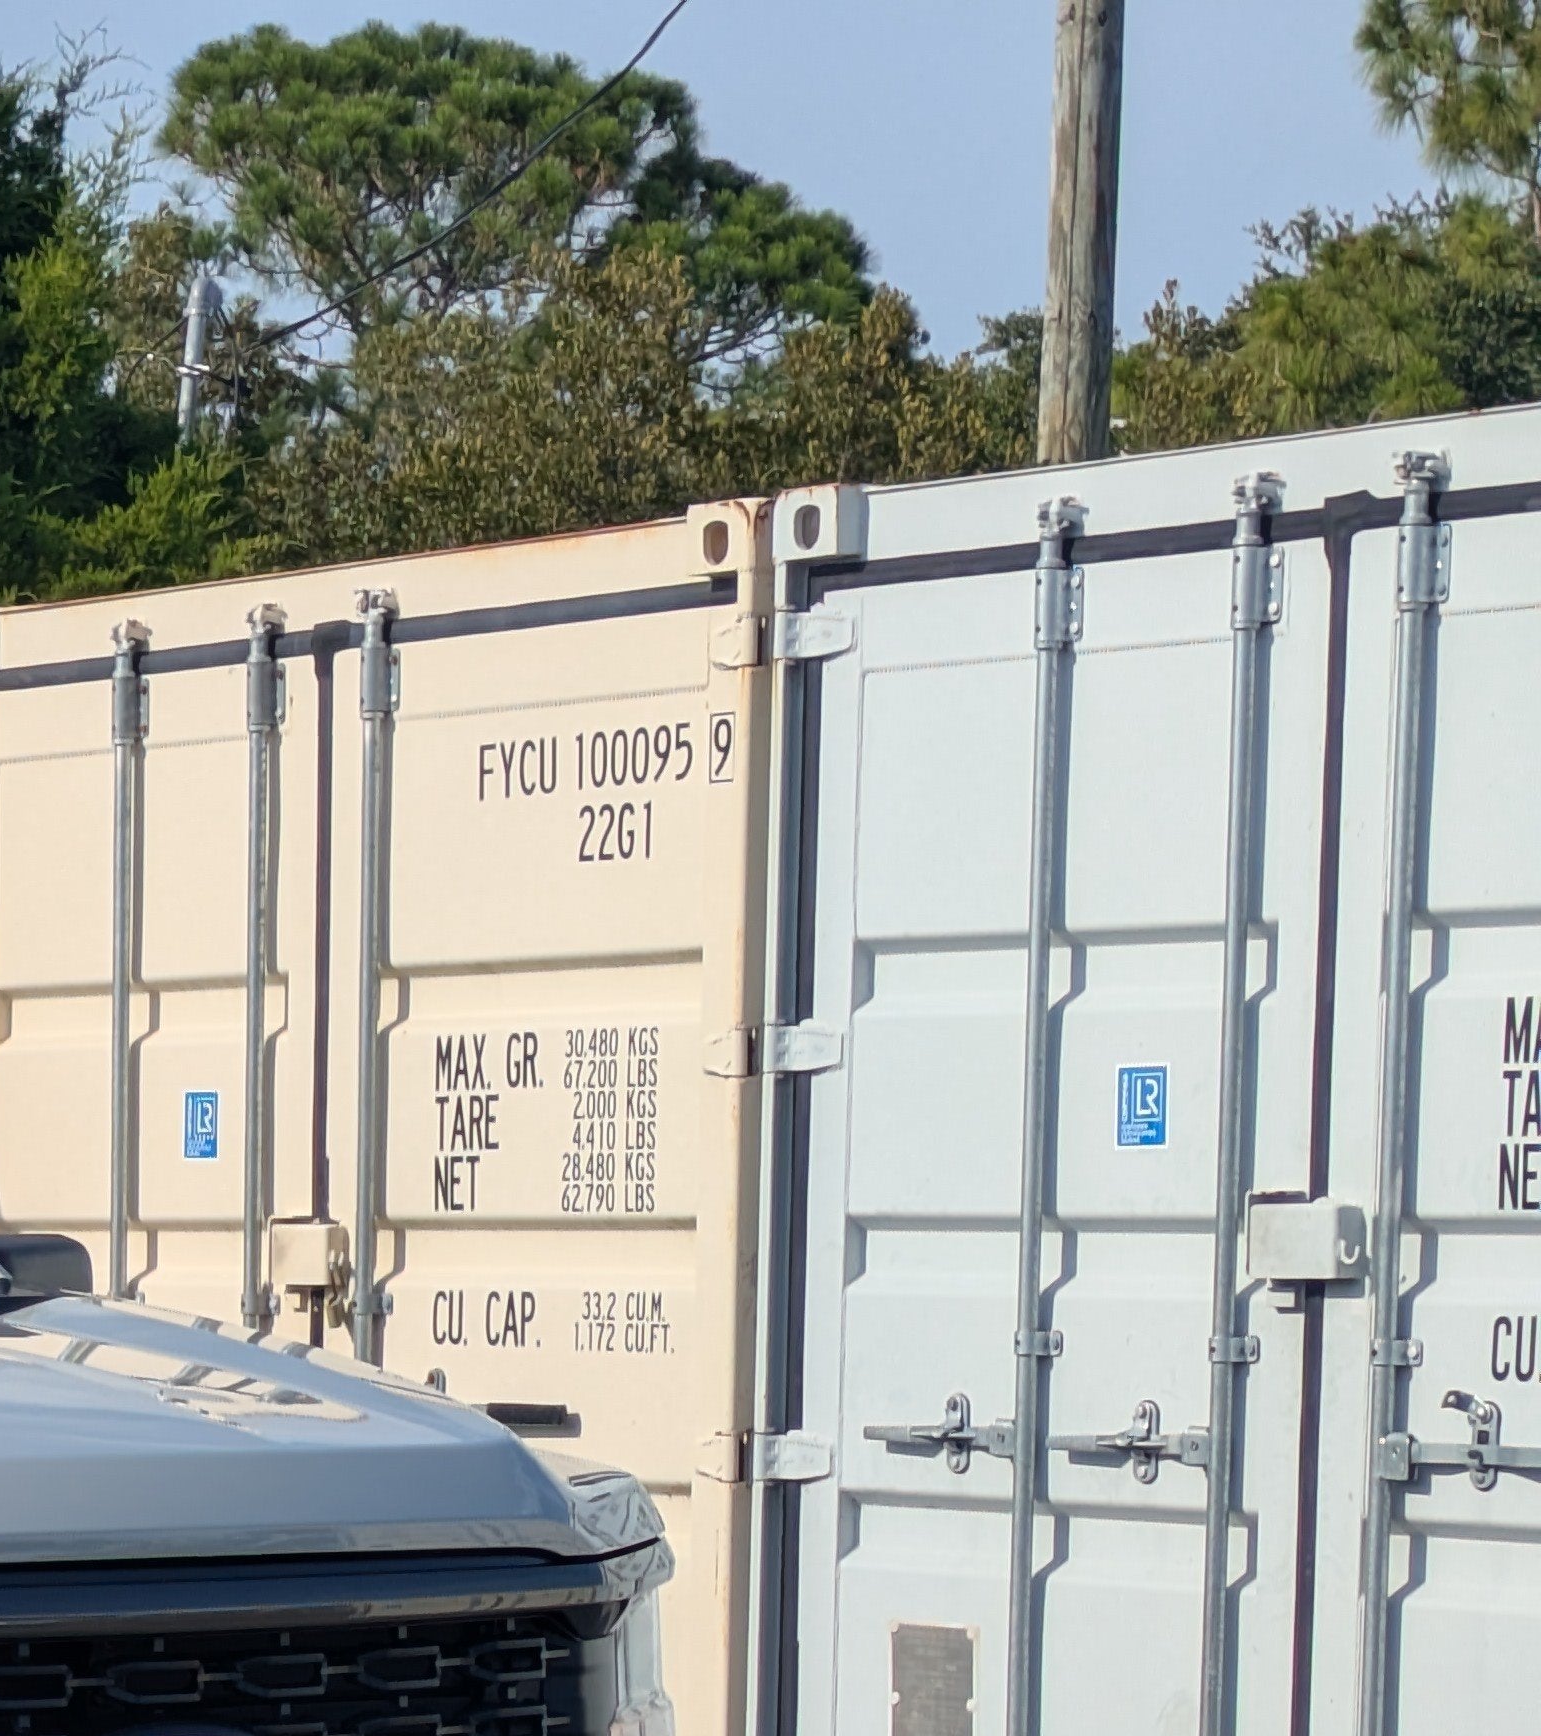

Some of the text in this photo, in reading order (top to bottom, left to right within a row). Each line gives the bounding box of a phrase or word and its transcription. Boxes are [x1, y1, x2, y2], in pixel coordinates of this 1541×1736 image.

[479, 718, 732, 801] FYCU 100095 9
[578, 801, 652, 862] 22G1
[435, 1034, 492, 1091] MAX.
[506, 1032, 544, 1089] GR.
[627, 1027, 659, 1057] KGS
[626, 1057, 658, 1088] LBS
[435, 1094, 500, 1151] TARE
[626, 1089, 657, 1119] KGS
[625, 1120, 656, 1150] LBS
[434, 1155, 481, 1212] NET
[625, 1152, 656, 1182] KGS
[624, 1183, 655, 1213] LBS
[432, 1290, 468, 1347] CU.
[485, 1291, 541, 1348] CAP.
[1491, 1315, 1541, 1383] CU
